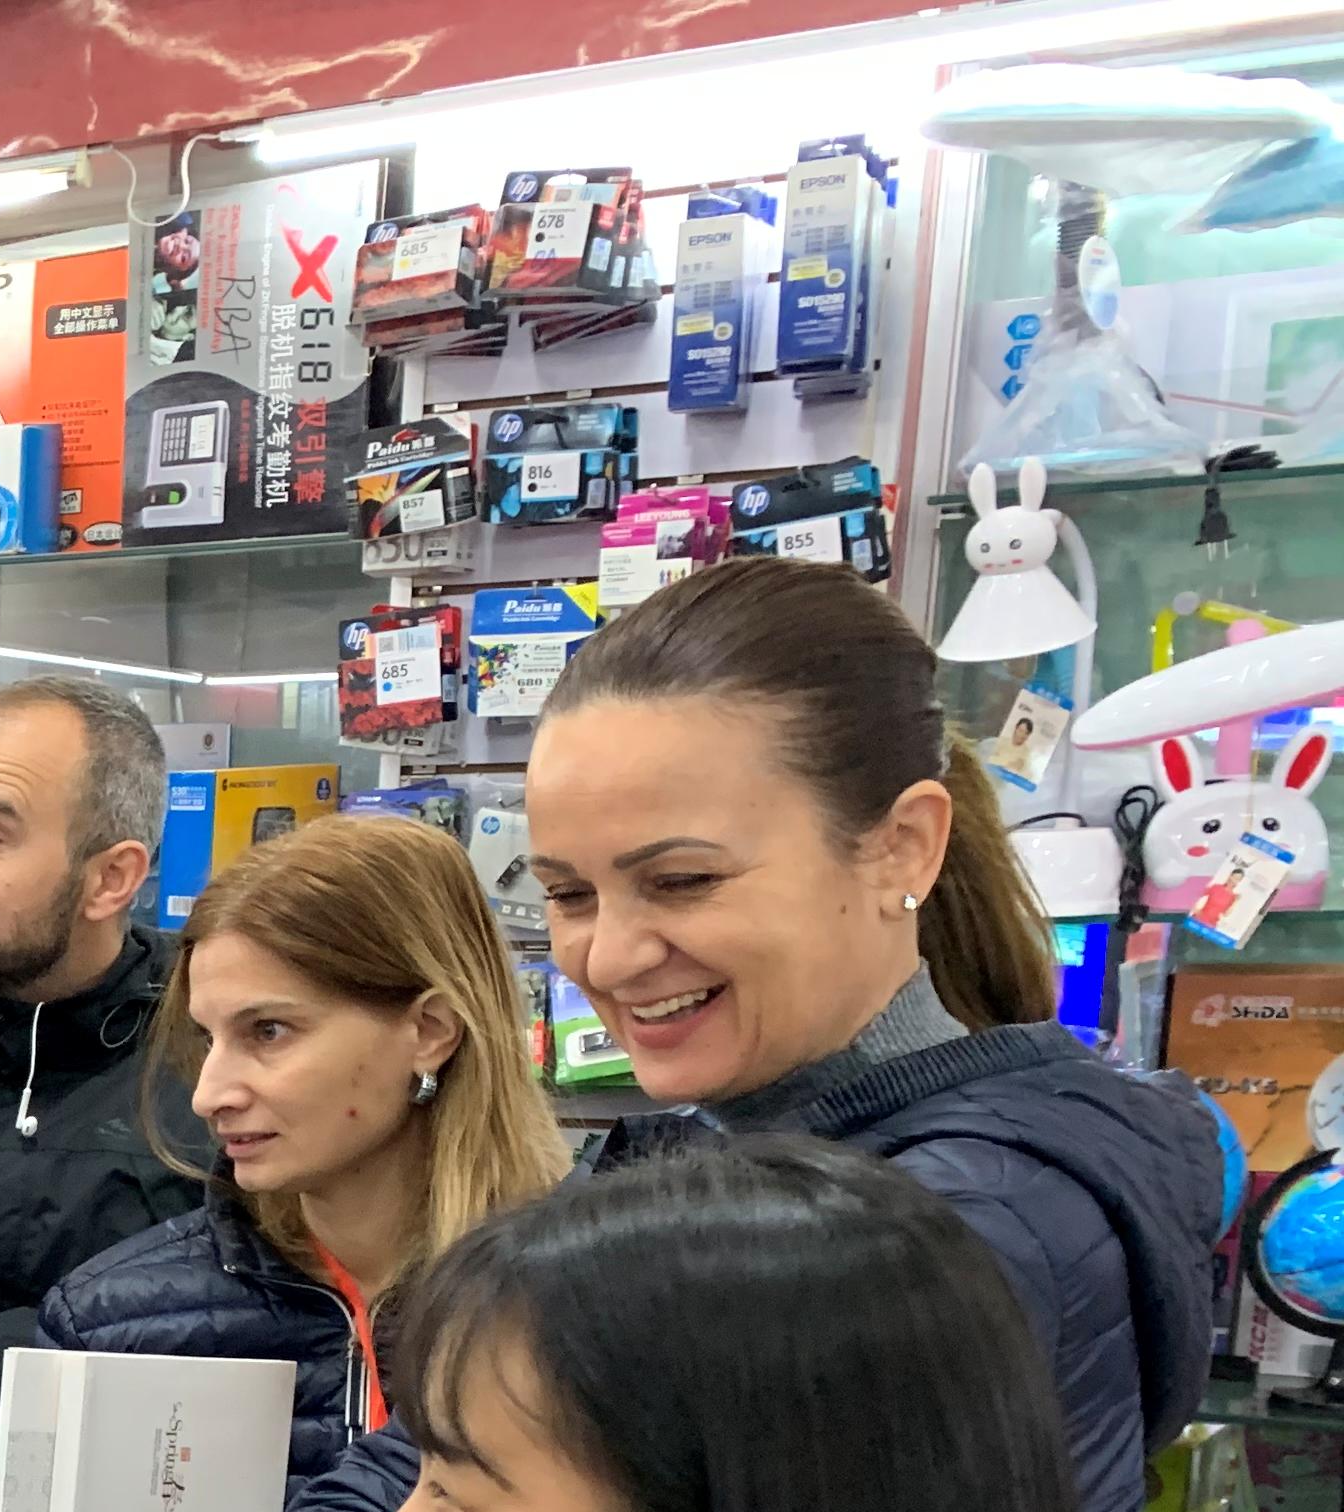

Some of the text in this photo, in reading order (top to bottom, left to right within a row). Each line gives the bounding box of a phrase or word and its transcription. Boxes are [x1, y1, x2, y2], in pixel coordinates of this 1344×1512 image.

[800, 174, 846, 190] EPSON
[537, 214, 565, 229] 678
[689, 232, 732, 246] EPSON
[400, 241, 429, 257] 685
[265, 302, 297, 509] 脱机指纹考勤机
[495, 414, 523, 442] hp
[367, 441, 410, 460] Paidu
[528, 465, 553, 479] 816
[740, 485, 770, 517] hp
[784, 532, 815, 551] 855
[504, 599, 541, 614] Paidu
[343, 621, 368, 651] hp
[381, 664, 409, 680] 685
